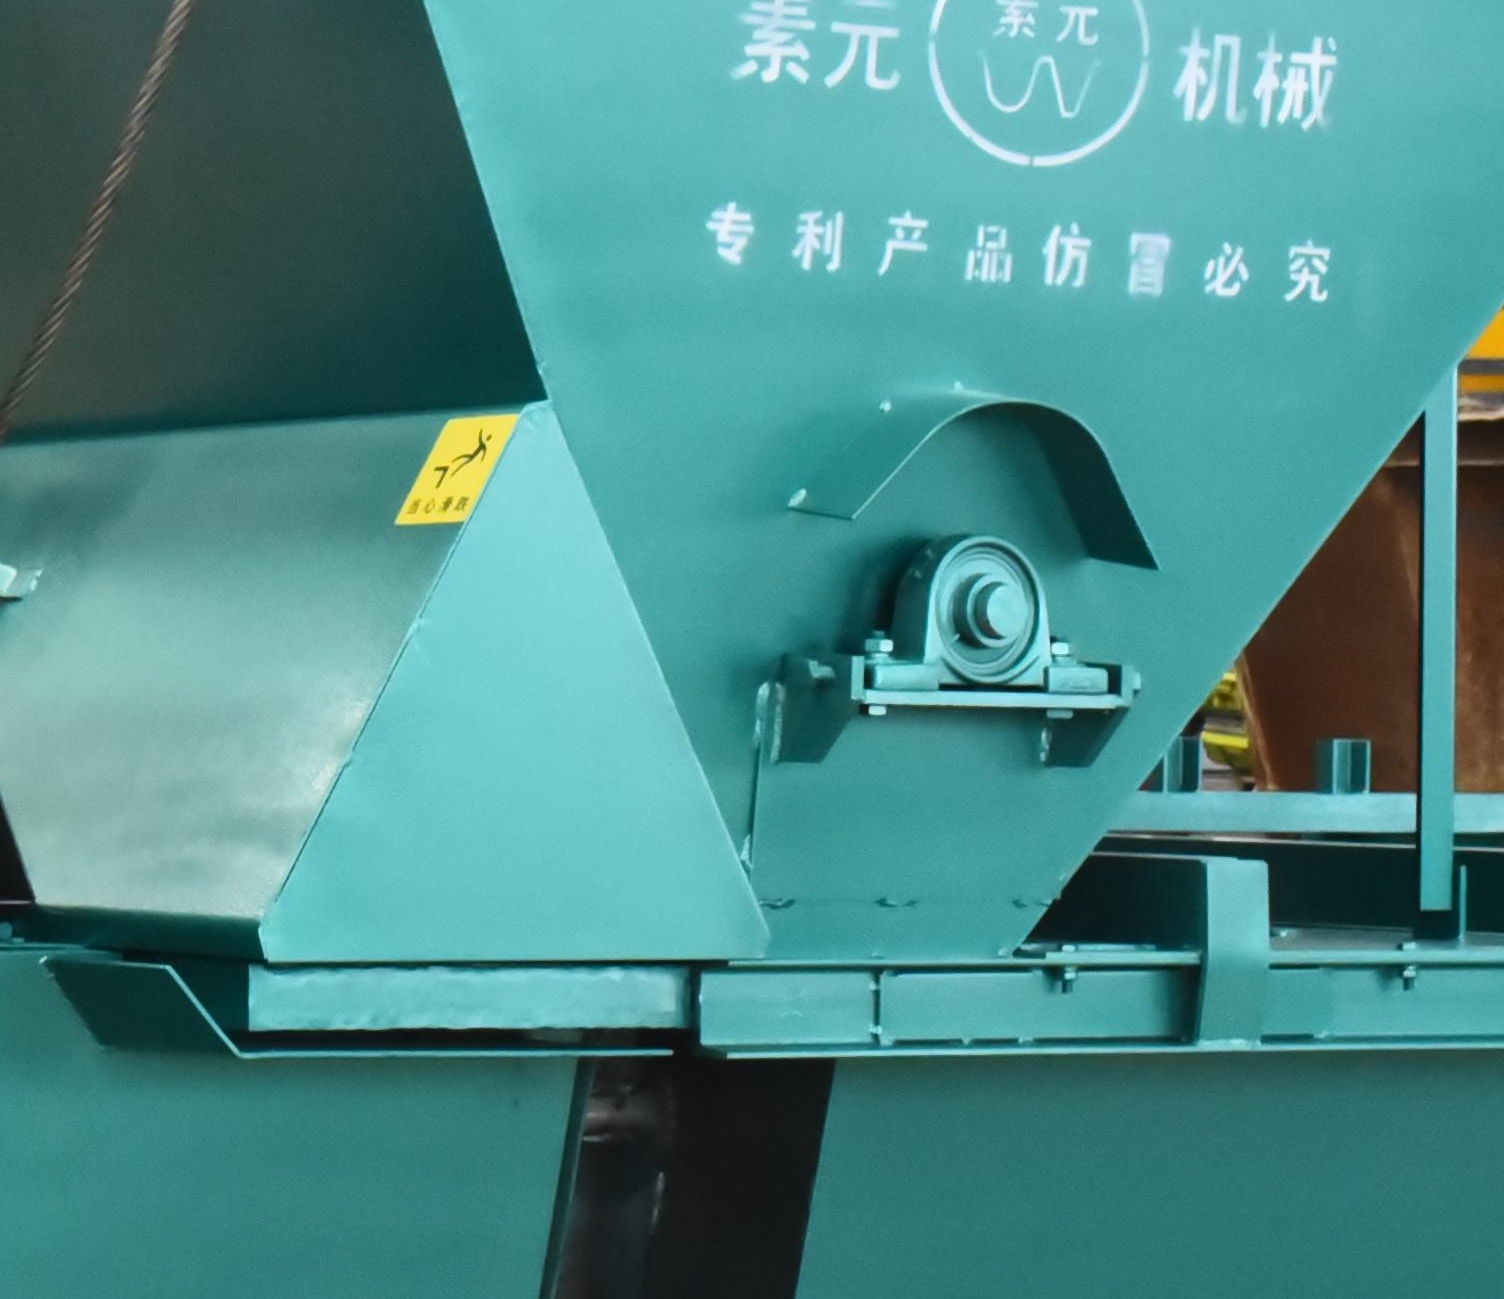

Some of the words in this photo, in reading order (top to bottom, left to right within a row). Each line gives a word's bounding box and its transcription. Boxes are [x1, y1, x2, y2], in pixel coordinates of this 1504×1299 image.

[1173, 26, 1340, 131] 机械
[705, 201, 1332, 302] 专利产品仿冒必究
